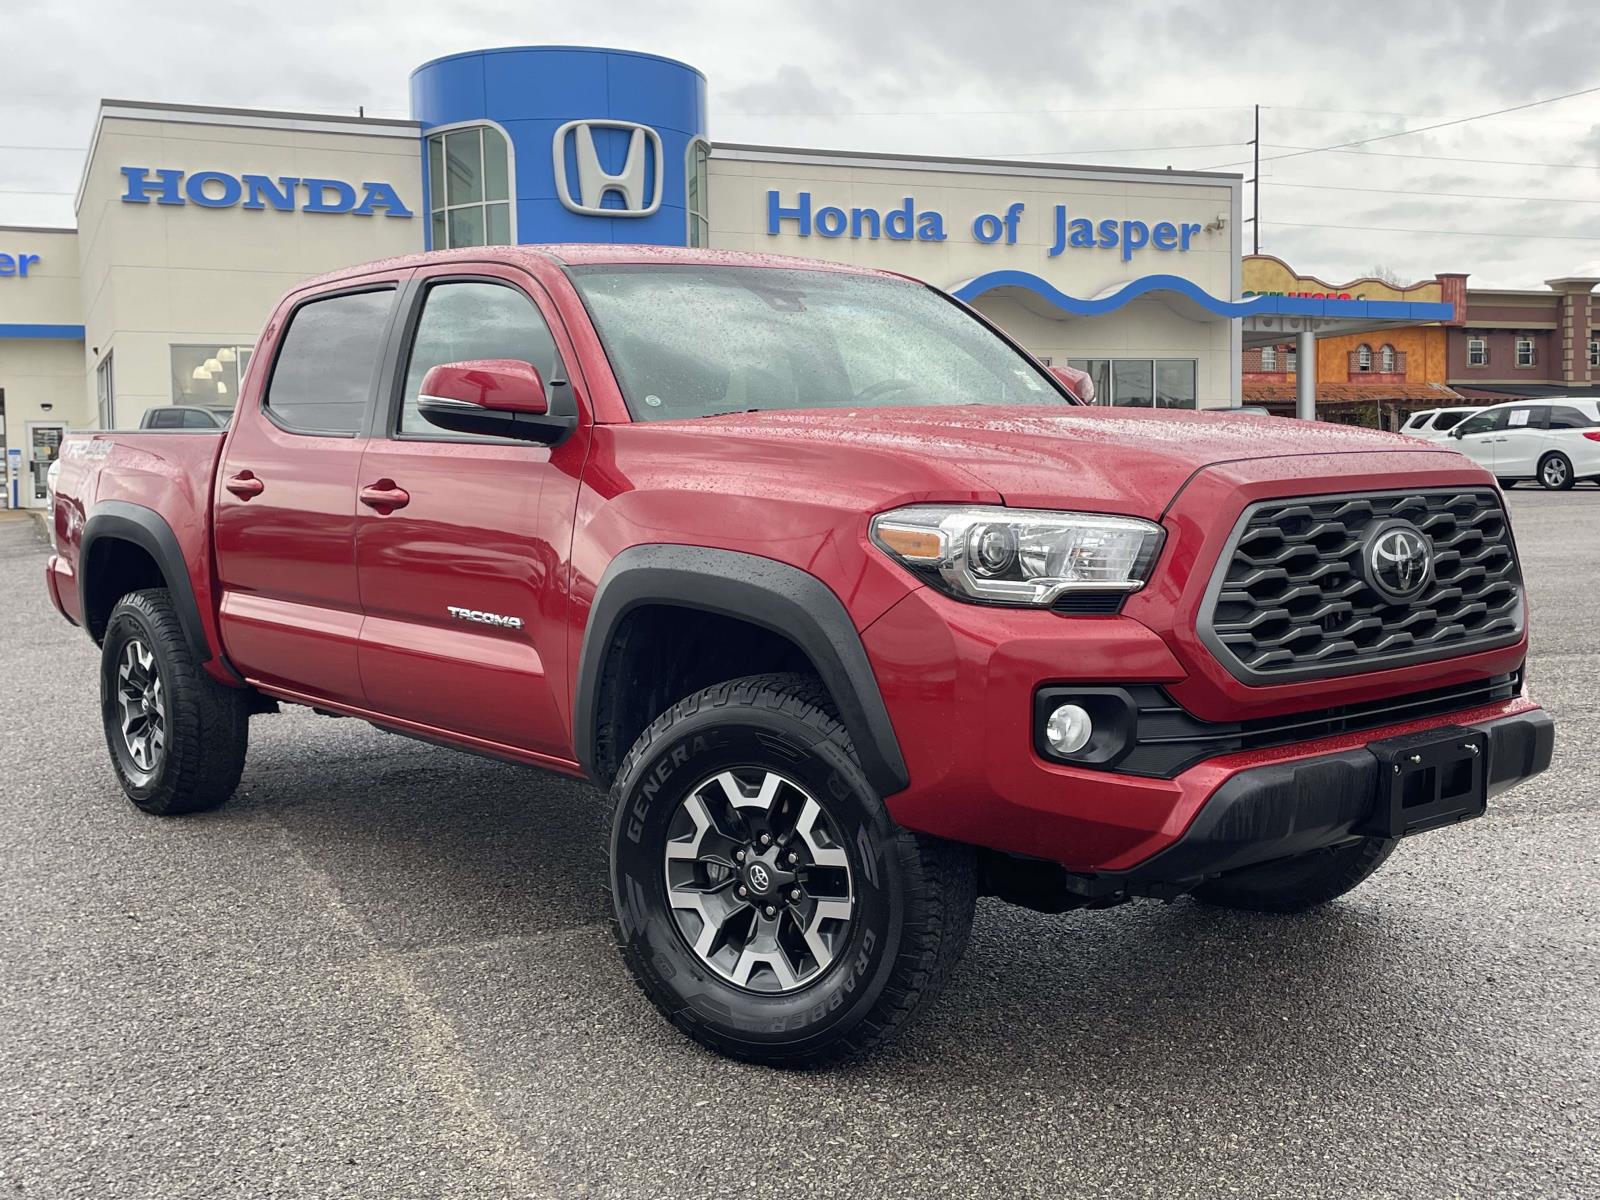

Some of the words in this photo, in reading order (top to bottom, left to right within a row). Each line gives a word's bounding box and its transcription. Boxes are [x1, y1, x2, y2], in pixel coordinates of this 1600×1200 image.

[120, 167, 413, 218] HONDA
[766, 191, 947, 242] Honda
[971, 202, 1025, 245] of
[1048, 204, 1201, 261] Jasper
[447, 606, 524, 628] TACOMA
[770, 927, 877, 1032] GRABBER
